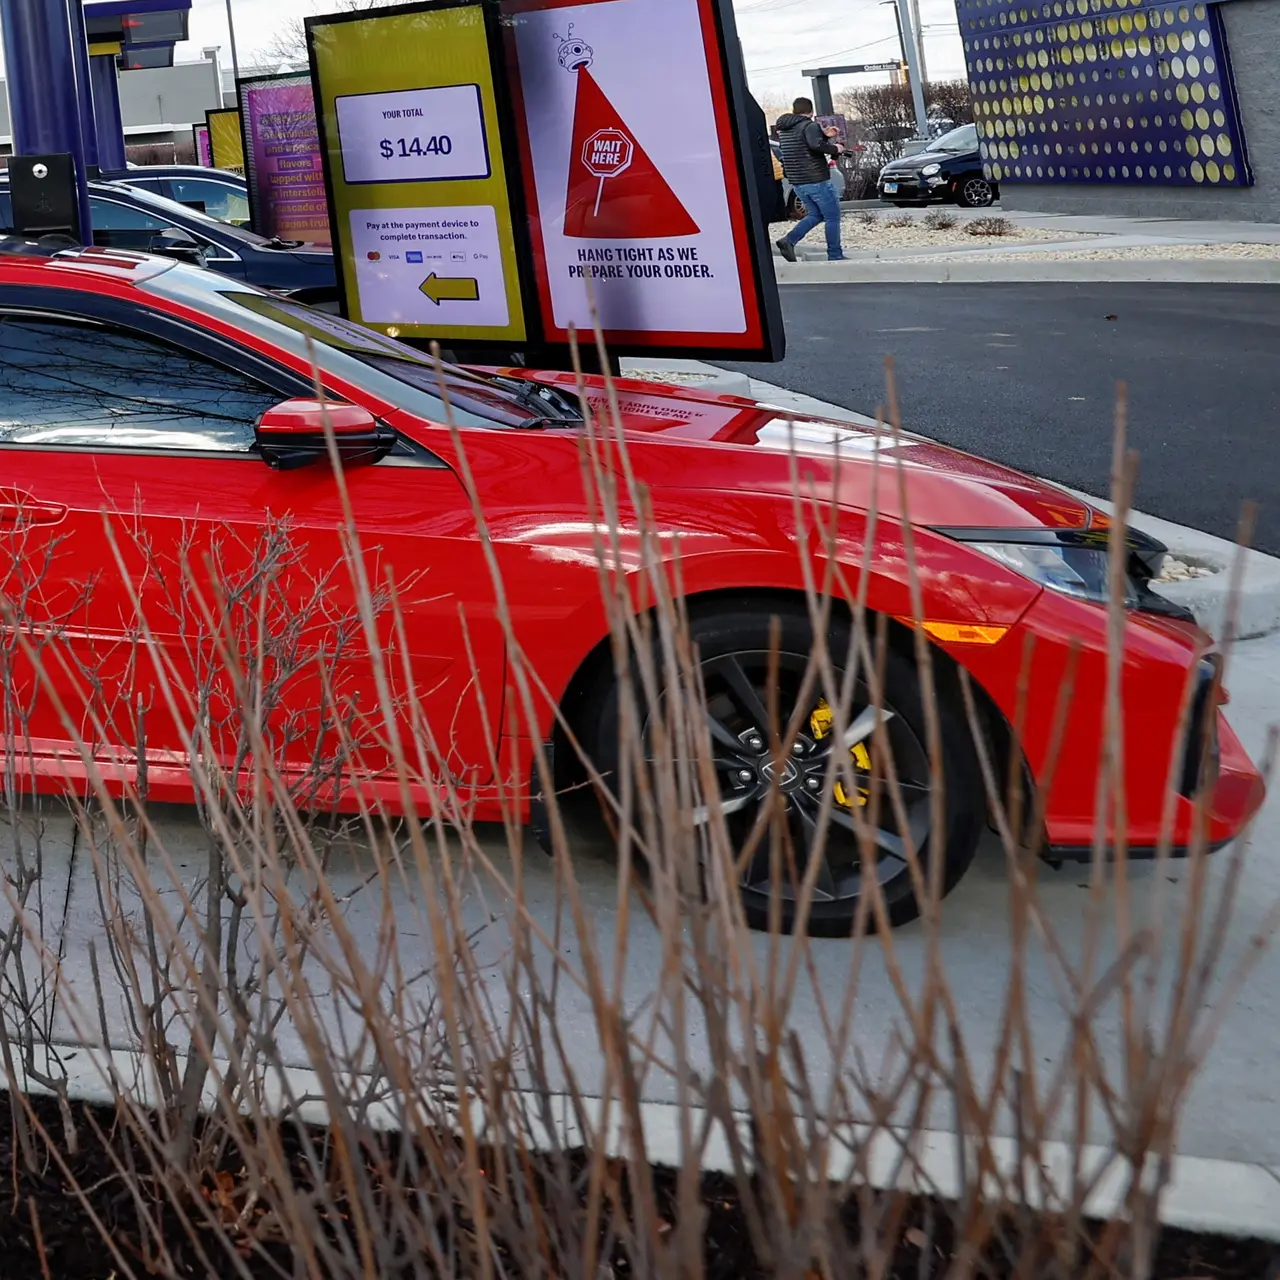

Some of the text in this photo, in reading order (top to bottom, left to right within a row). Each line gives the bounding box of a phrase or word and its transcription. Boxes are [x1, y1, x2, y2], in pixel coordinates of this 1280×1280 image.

[382, 108, 424, 119] YOUR TOTAL
[380, 135, 452, 160] $ 14.40
[593, 140, 623, 152] WAIT
[279, 159, 312, 169] flavors
[591, 152, 621, 165] HERE
[270, 172, 303, 185] topped
[366, 222, 380, 231] Pay
[391, 221, 404, 229] the
[405, 221, 440, 230] payment
[441, 220, 468, 228] device
[380, 231, 468, 242] complete transaction.
[577, 247, 698, 262] HANG TIGHT AS WE
[568, 264, 715, 278] PRPARE YOUR ORDER.
